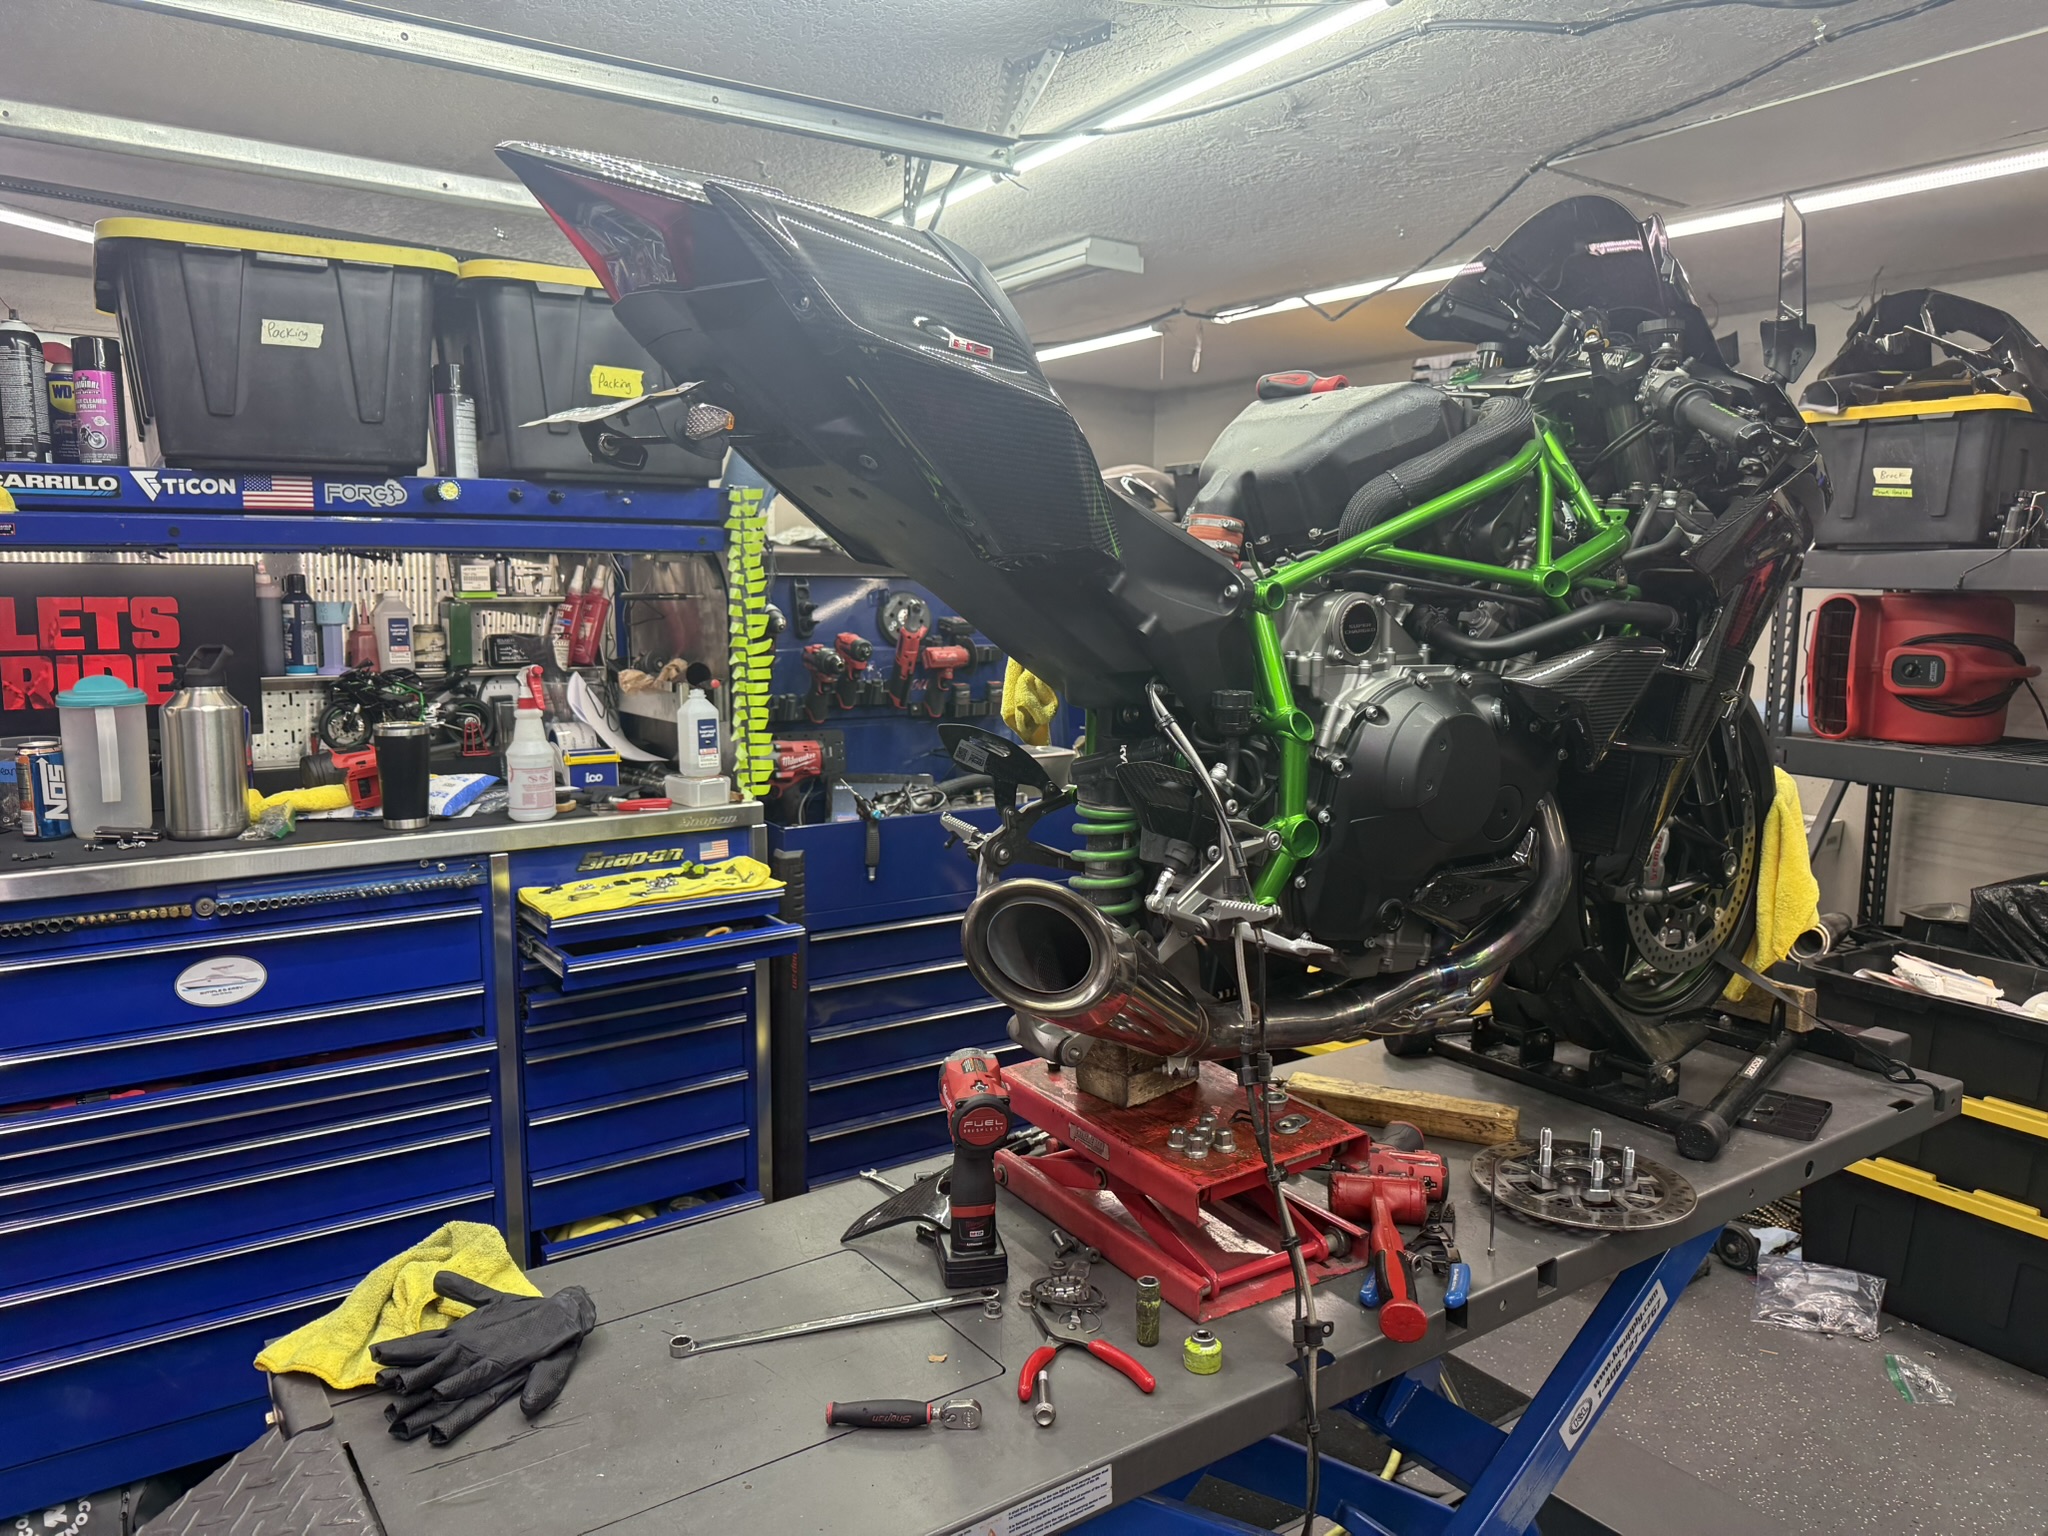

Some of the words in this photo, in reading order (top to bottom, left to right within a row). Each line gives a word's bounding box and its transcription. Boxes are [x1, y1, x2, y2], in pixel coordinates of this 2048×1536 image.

[598, 372, 631, 395] Packing
[0, 473, 118, 491] ARRILLO
[0, 596, 181, 650] LETS
[36, 757, 69, 820] NOS
[680, 814, 738, 828] Snap-on
[577, 847, 685, 872] Snap-on
[963, 1119, 1004, 1128] FUEL
